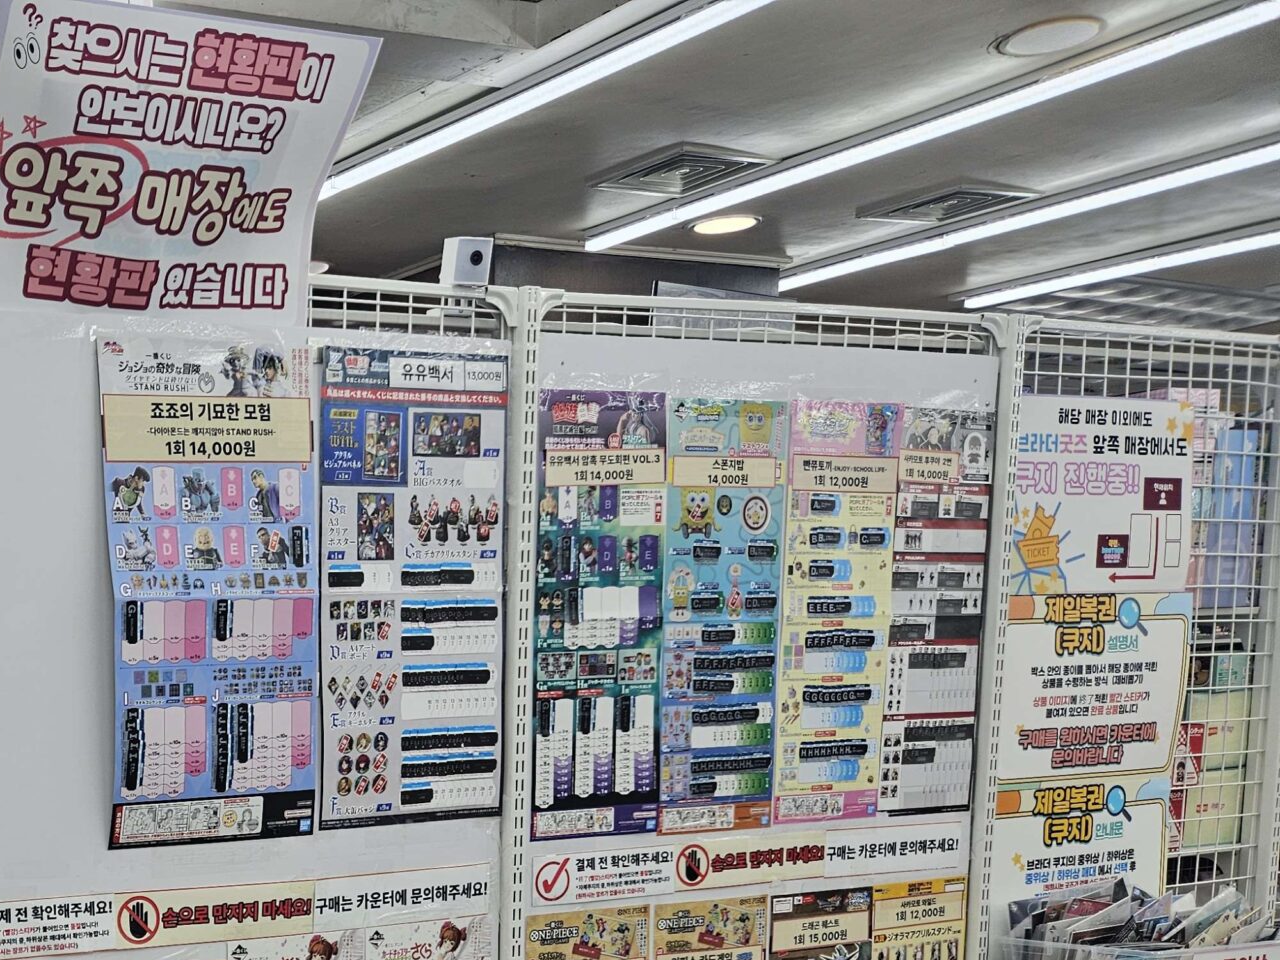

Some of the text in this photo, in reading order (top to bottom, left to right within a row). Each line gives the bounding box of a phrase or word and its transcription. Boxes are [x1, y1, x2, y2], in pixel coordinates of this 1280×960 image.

[46, 16, 334, 103] 찾으시는 현황판이
[73, 84, 287, 154] 안보이시나요?
[0, 143, 291, 246] 앞쪽 매장에도
[23, 244, 289, 309] 현황판 있습니다
[119, 361, 201, 375] ジョジョの奇妙な冒険
[401, 363, 502, 383] 유유백서 13,000원
[151, 403, 271, 421] 죠죠의 기묘한 모험
[1058, 408, 1152, 427] 해당 매장 이외에도
[166, 440, 255, 459] 1회 14,000원
[1018, 433, 1188, 456] 브라더굿즈 앞쪽 매장에서도
[549, 453, 660, 467] 유유백서 무도회편 VOL.3
[712, 459, 744, 471] 스폰지밥
[574, 469, 633, 482] 1회 14,000원
[708, 473, 748, 486] 14,000원
[814, 476, 868, 488] 1회 12,000원
[906, 468, 948, 480] 1회 14,000원
[1016, 461, 1140, 495] 쿠지 진행중!!
[1026, 547, 1050, 558] TICKET
[1044, 595, 1116, 623] 제일복권
[1055, 626, 1138, 655] (쿠지) 설명서
[1018, 722, 1157, 749] 구매를 원하시면 카운터에
[1051, 745, 1124, 769] 문의바랍니다
[1033, 784, 1105, 816] 제일복권
[1043, 814, 1123, 848] (쿠지) 안내문
[711, 845, 824, 872] 손으로 만지지 마세요!
[827, 838, 958, 861] 구매는 카운터에 문의해주세요!
[1027, 849, 1134, 871] 브라더 쿠지의 중위상 하위상은
[576, 851, 673, 872] 결제 전 확인해주세요!
[315, 882, 487, 914] 구매는 카운터에 문의해주세요!
[901, 897, 936, 908] 사카모토 와일드
[15, 907, 28, 922] 전
[31, 901, 112, 920] 확인해주세요!
[162, 898, 312, 929] 손으로 만지지 마세요!
[896, 908, 945, 921] 1회 12,000원
[802, 918, 839, 931] 드래곤 퀘스트
[887, 927, 952, 942] ジオラマアクリルスタンド
[794, 929, 847, 945] 1회 15,000원
